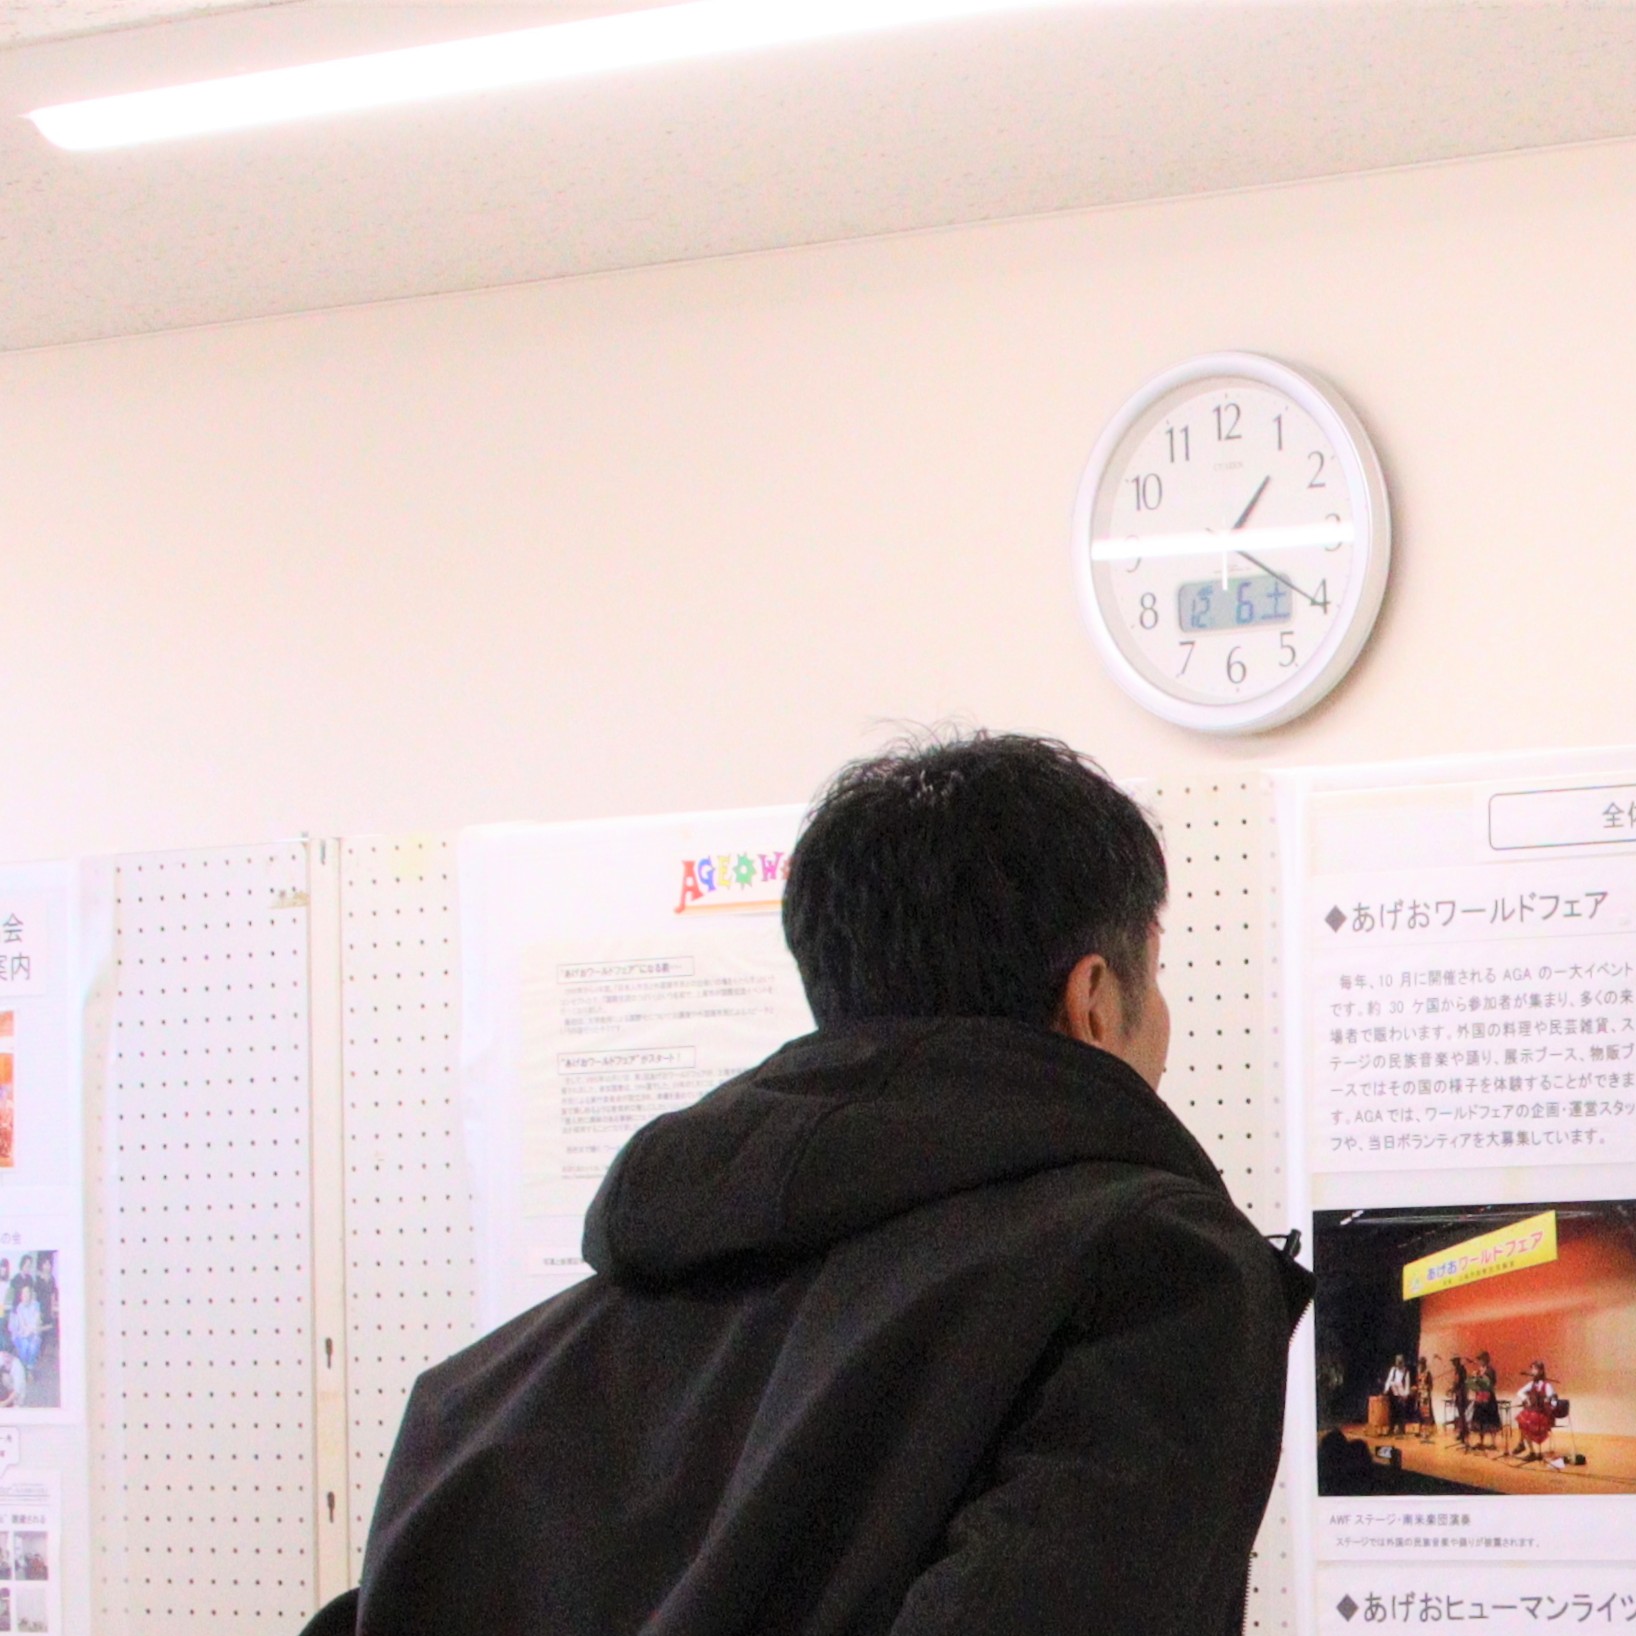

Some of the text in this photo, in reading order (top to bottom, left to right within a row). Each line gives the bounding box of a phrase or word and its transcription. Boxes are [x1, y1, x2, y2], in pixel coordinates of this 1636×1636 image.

[1213, 403, 1242, 440] 12
[1274, 414, 1283, 450] 1
[1165, 426, 1189, 462] 11
[1308, 451, 1325, 488] 2
[1132, 473, 1162, 511] 10
[1140, 593, 1158, 629] 8
[1236, 583, 1253, 623] 6
[1309, 579, 1331, 614] 4
[1179, 641, 1195, 676] 7
[1226, 646, 1247, 684] 6
[1279, 632, 1297, 667] 5
[3, 912, 24, 944] 会
[1352, 891, 1609, 932] あげおワールドフェア
[1503, 969, 1531, 982] AGA
